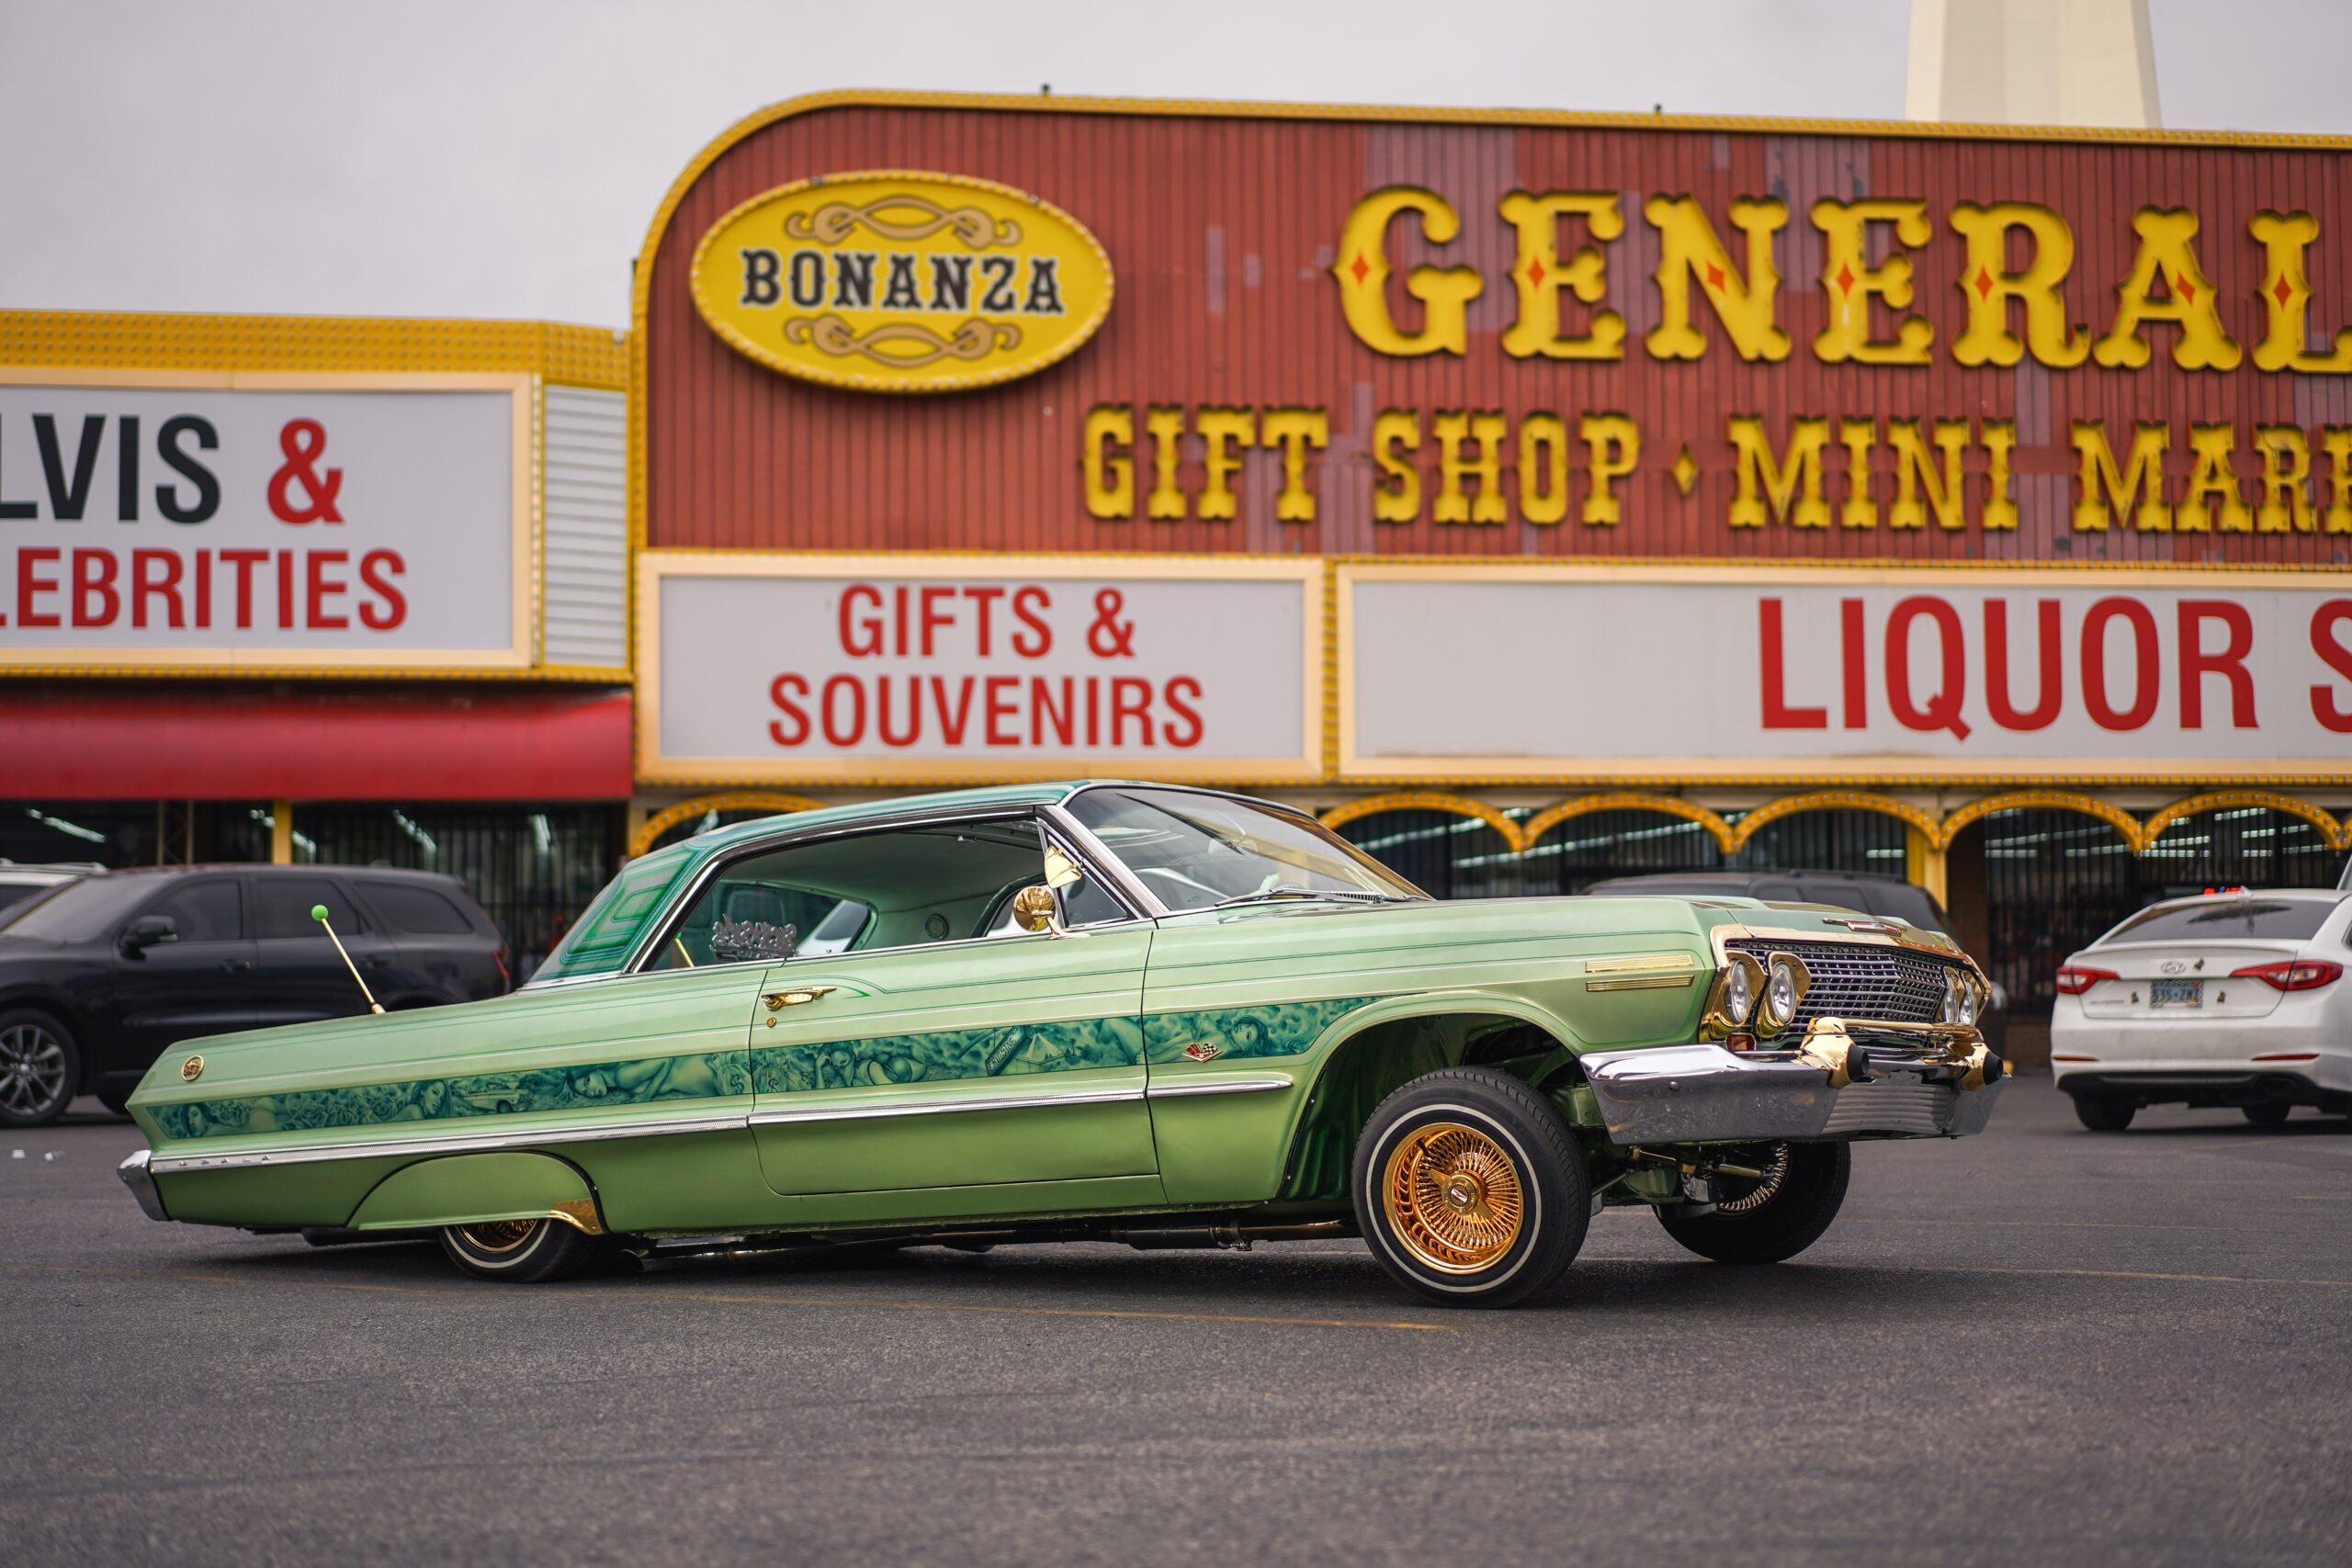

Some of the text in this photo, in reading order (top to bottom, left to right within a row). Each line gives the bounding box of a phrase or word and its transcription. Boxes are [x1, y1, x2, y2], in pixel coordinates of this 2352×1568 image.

[741, 247, 1065, 315] BONANZA
[1331, 186, 2352, 374] GENERAL
[266, 418, 345, 525] &
[1083, 402, 1329, 522] GIFT
[1373, 408, 1640, 526] SHOP
[1727, 413, 2019, 530] MINI
[0, 547, 408, 632] EBRITIES
[837, 584, 1136, 659] GIFTS &
[768, 673, 1204, 748] SOUVENIRS
[1758, 595, 2260, 740] LIQUOR
